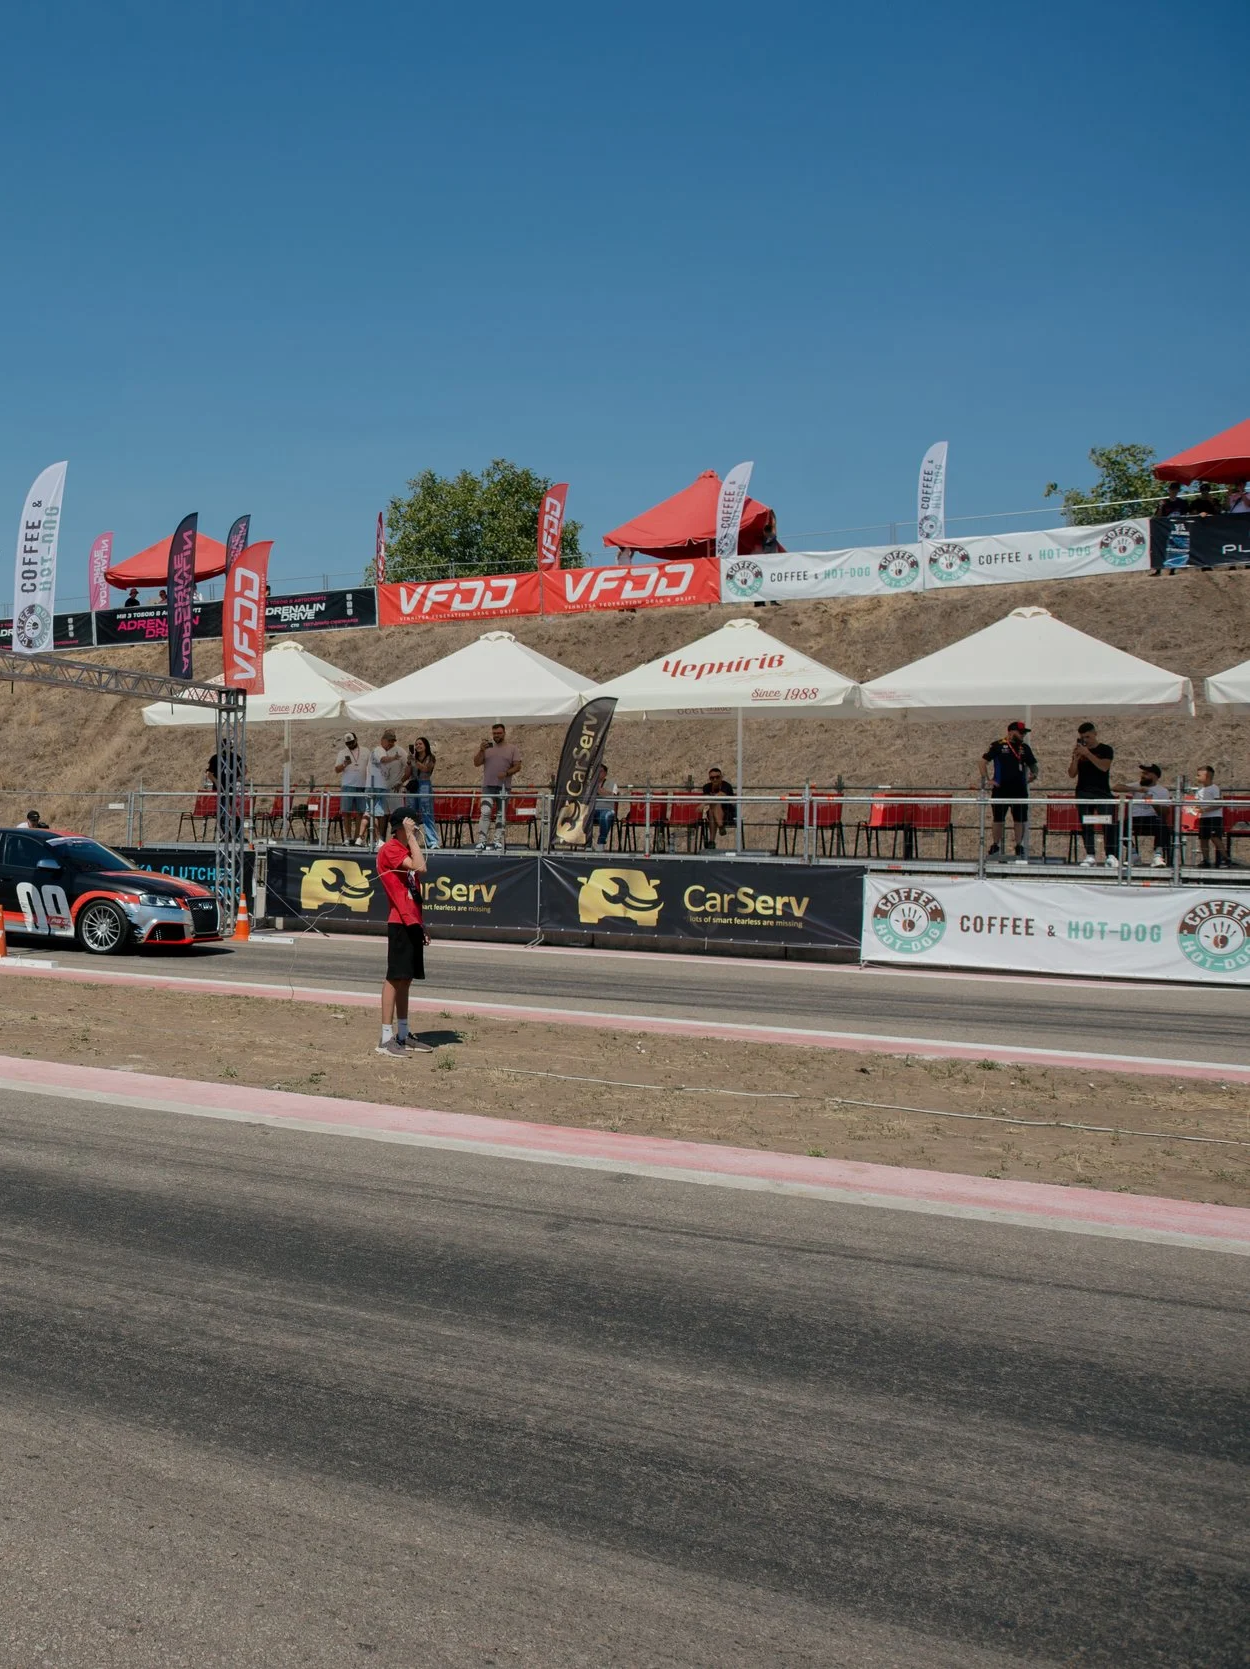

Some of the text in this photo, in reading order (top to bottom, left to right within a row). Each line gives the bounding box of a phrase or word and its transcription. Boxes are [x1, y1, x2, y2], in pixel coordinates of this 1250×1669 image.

[920, 469, 934, 510] COFFEE
[721, 490, 736, 529] COFFEE
[541, 496, 562, 564] VFDD
[1104, 527, 1142, 543] COFFEE
[20, 500, 42, 593] COFFEE &
[881, 551, 916, 566] COFFEE
[931, 543, 968, 560] COFFEE
[978, 552, 1021, 566] COFFEE
[1039, 546, 1091, 561] HOT-DOG
[727, 560, 763, 576] COFFEE
[770, 571, 809, 583] COFFEE
[824, 567, 871, 580] HOT-DOG
[400, 578, 517, 615] VFDD
[565, 563, 694, 603] VFDD
[265, 602, 326, 616] DRENALIN
[281, 612, 316, 622] DRIVE
[16, 607, 31, 647] COFFEE
[234, 567, 260, 680] VFDD
[662, 653, 785, 680] Чернігів
[751, 688, 819, 700] Since 1988
[268, 703, 317, 714] Since 1988
[566, 711, 599, 797] CarServ
[421, 876, 497, 903] rServ
[683, 885, 810, 917] CarServ
[877, 888, 941, 913] COFFEE
[468, 906, 492, 914] missing
[733, 917, 761, 926] fearless
[775, 920, 803, 929] missing
[875, 923, 941, 952] HOT-DOG
[959, 915, 1163, 943] COFFEE & HOT-DOG
